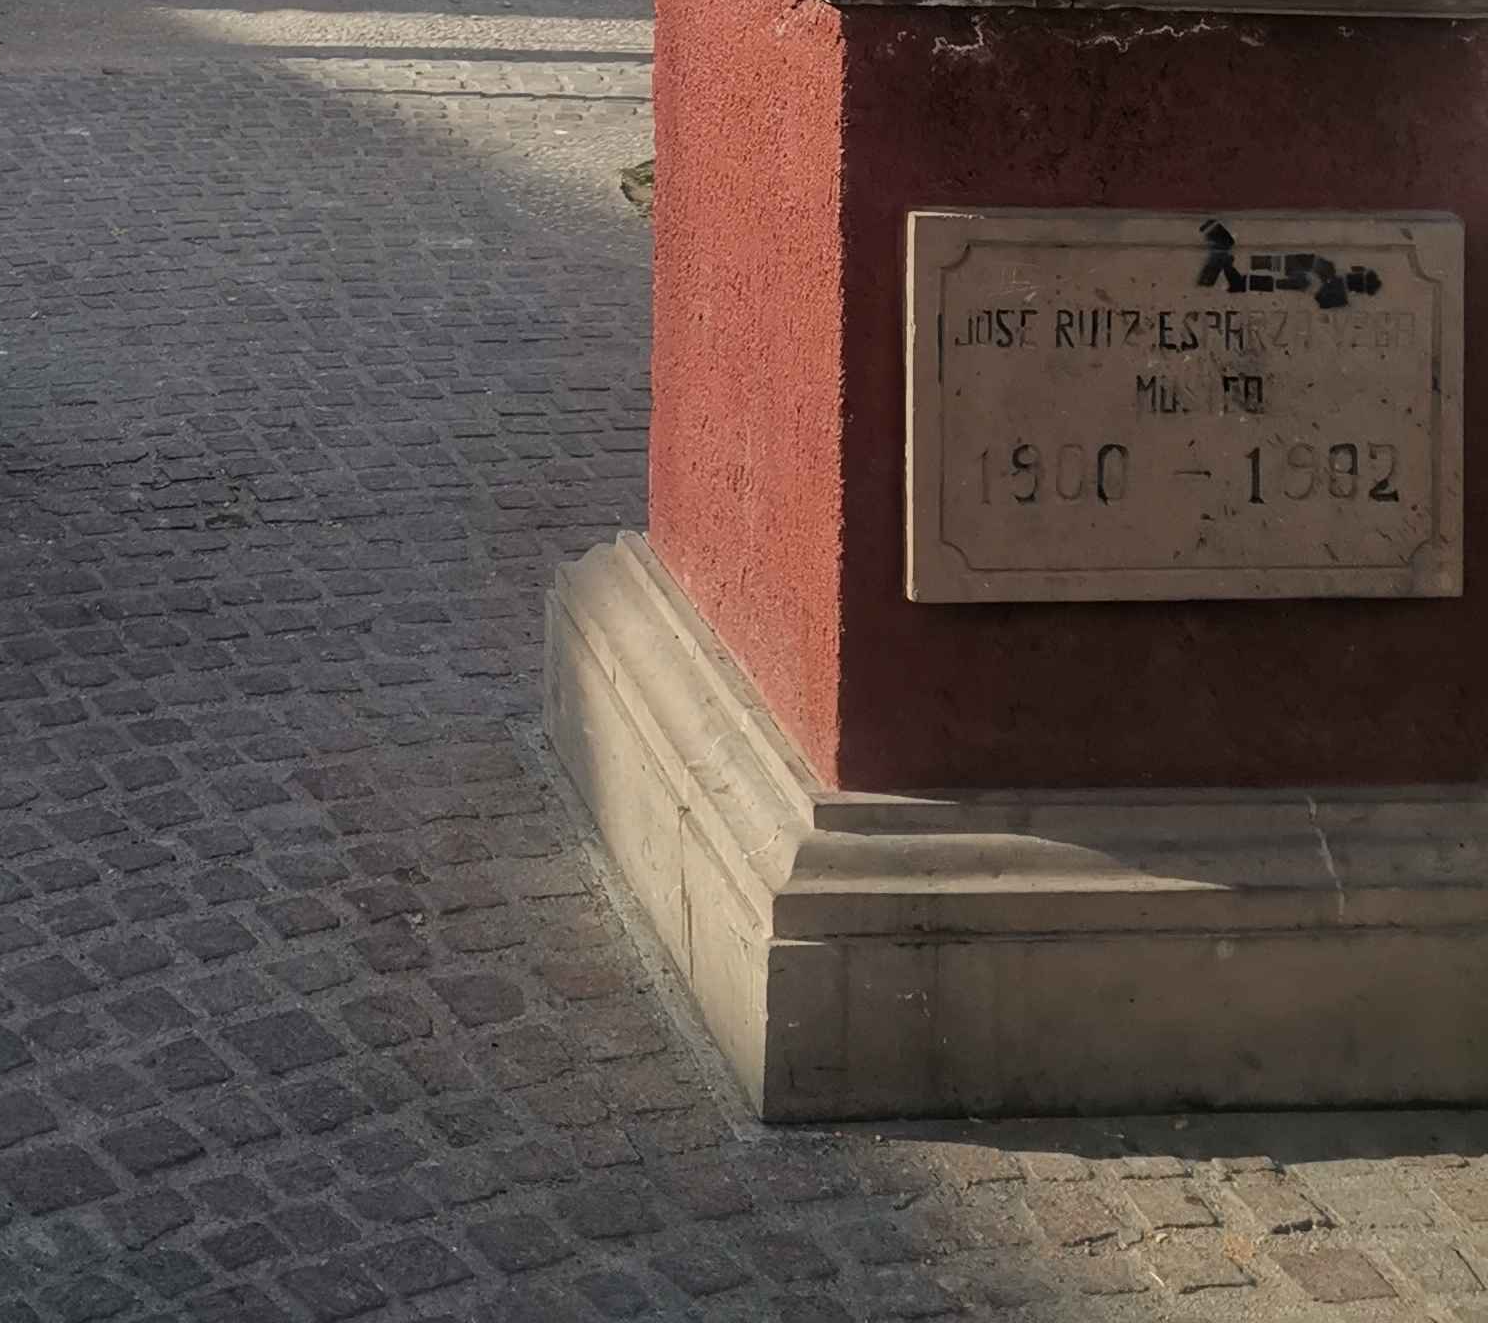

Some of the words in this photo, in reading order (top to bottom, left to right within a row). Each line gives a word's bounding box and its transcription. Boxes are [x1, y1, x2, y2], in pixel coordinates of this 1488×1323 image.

[954, 308, 1039, 348] JOSE
[1054, 308, 1141, 349] RUIZ
[978, 442, 1130, 506] 1900
[1245, 442, 1401, 505] 1982
